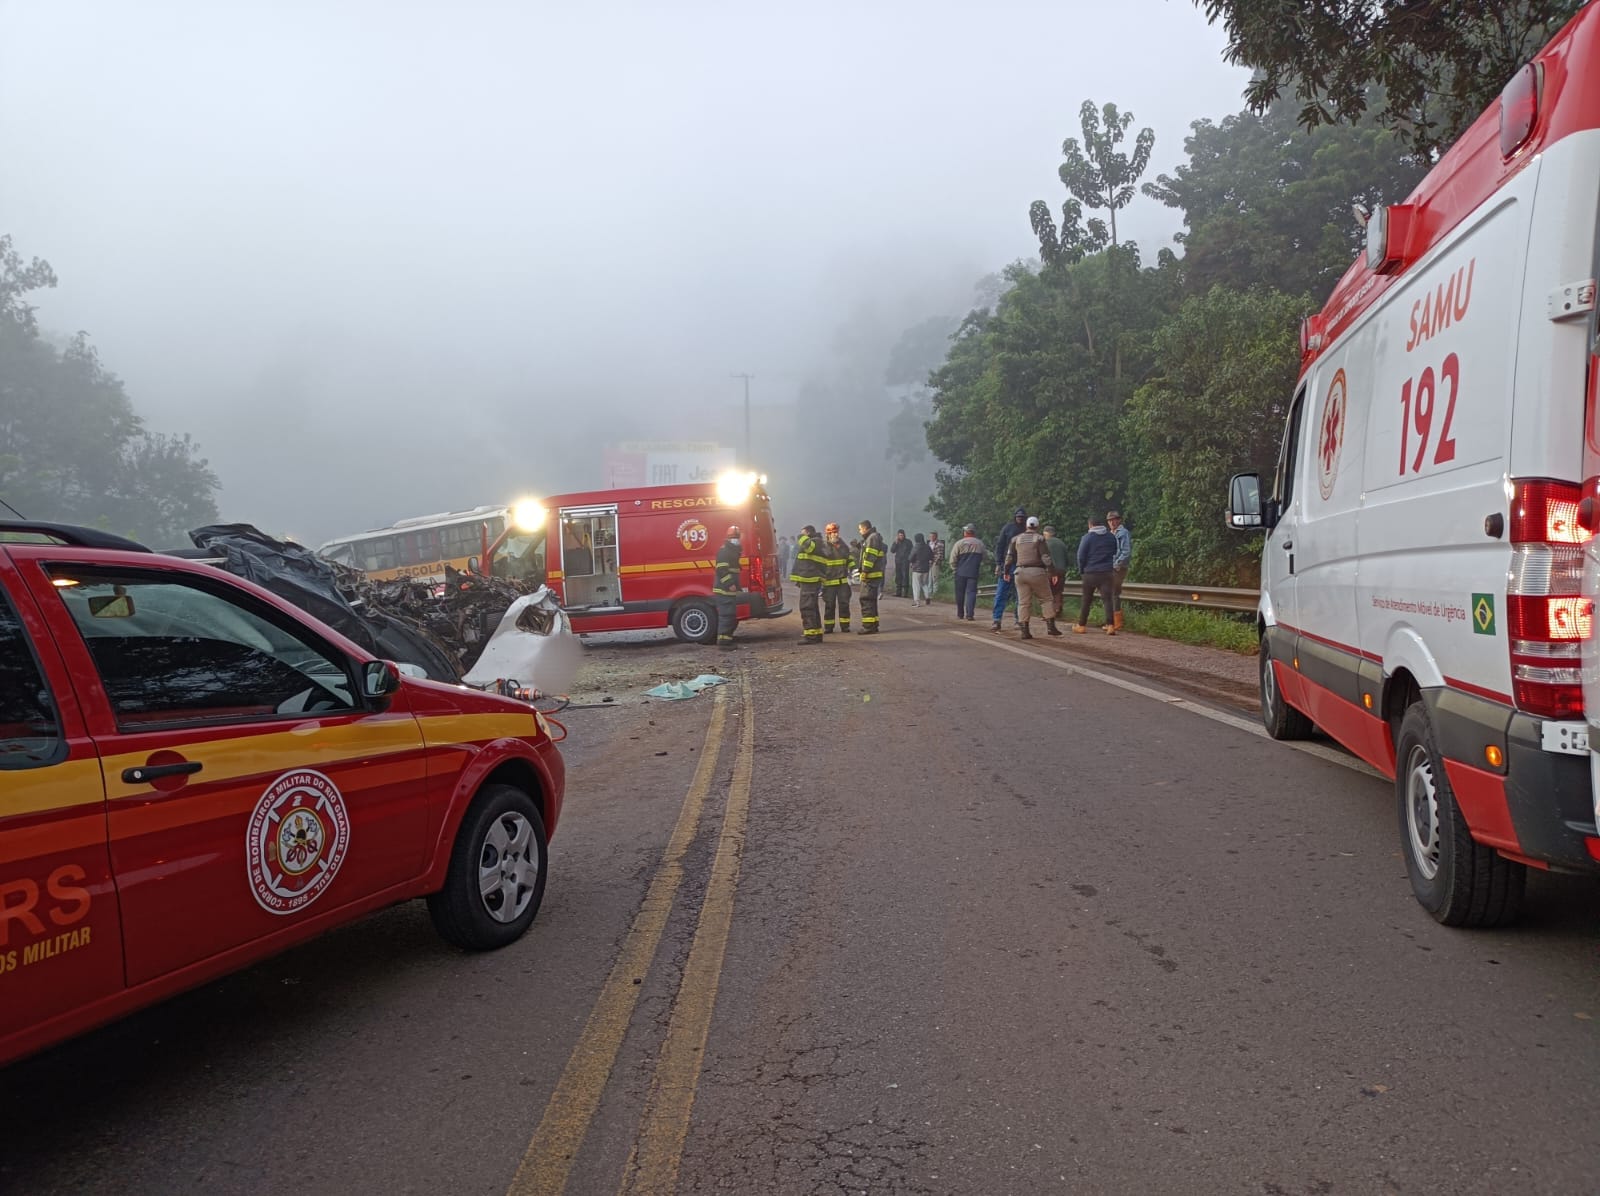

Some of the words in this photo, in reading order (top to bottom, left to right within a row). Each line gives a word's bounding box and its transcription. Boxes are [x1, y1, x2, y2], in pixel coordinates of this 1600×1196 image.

[1406, 256, 1476, 353] SAMU
[1399, 352, 1460, 476] 192
[652, 463, 679, 484] FIAT
[682, 529, 706, 542] 193
[275, 775, 311, 796] MILITAR
[312, 777, 325, 789] DO
[324, 786, 337, 803] RIO
[250, 794, 276, 865] BOMBEIROS
[334, 804, 347, 852] GRANDE
[330, 855, 341, 871] DO
[252, 867, 262, 884] DE
[314, 873, 330, 891] SUL
[258, 885, 282, 908] CORPO
[23, 926, 91, 966] MILITAR
